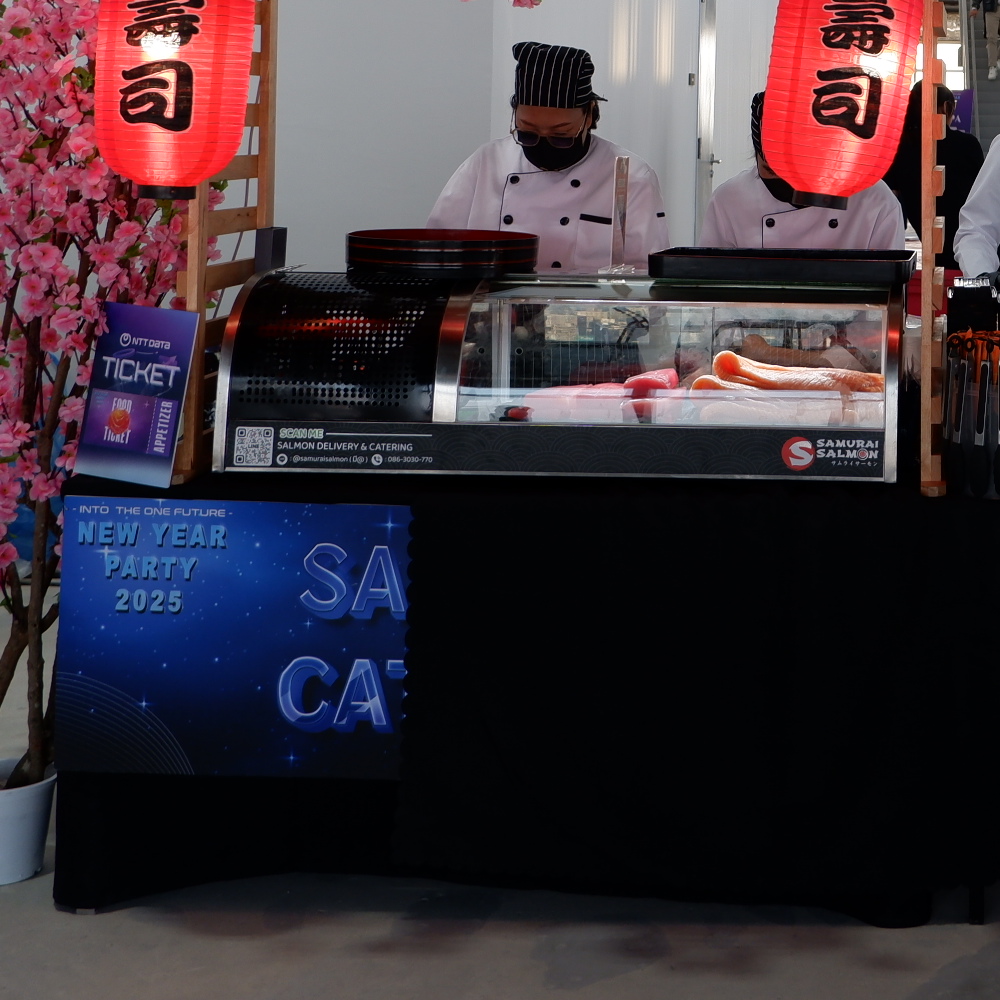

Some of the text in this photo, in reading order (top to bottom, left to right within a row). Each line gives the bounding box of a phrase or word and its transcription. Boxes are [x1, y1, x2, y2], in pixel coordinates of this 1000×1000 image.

[131, 337, 149, 348] NTT
[102, 355, 181, 388] TICKET
[153, 401, 173, 453] APPETIZER
[279, 428, 324, 439] SCAN ME
[277, 441, 413, 452] SALMON DELIVERY & CATERING
[816, 439, 879, 449] SAMURAI
[816, 448, 879, 460] SALMON
[79, 505, 226, 517] INTO THE ONE FUTURE
[78, 521, 227, 548] NEW YEAR
[105, 555, 197, 581] PARTY
[115, 588, 183, 614] 2025
